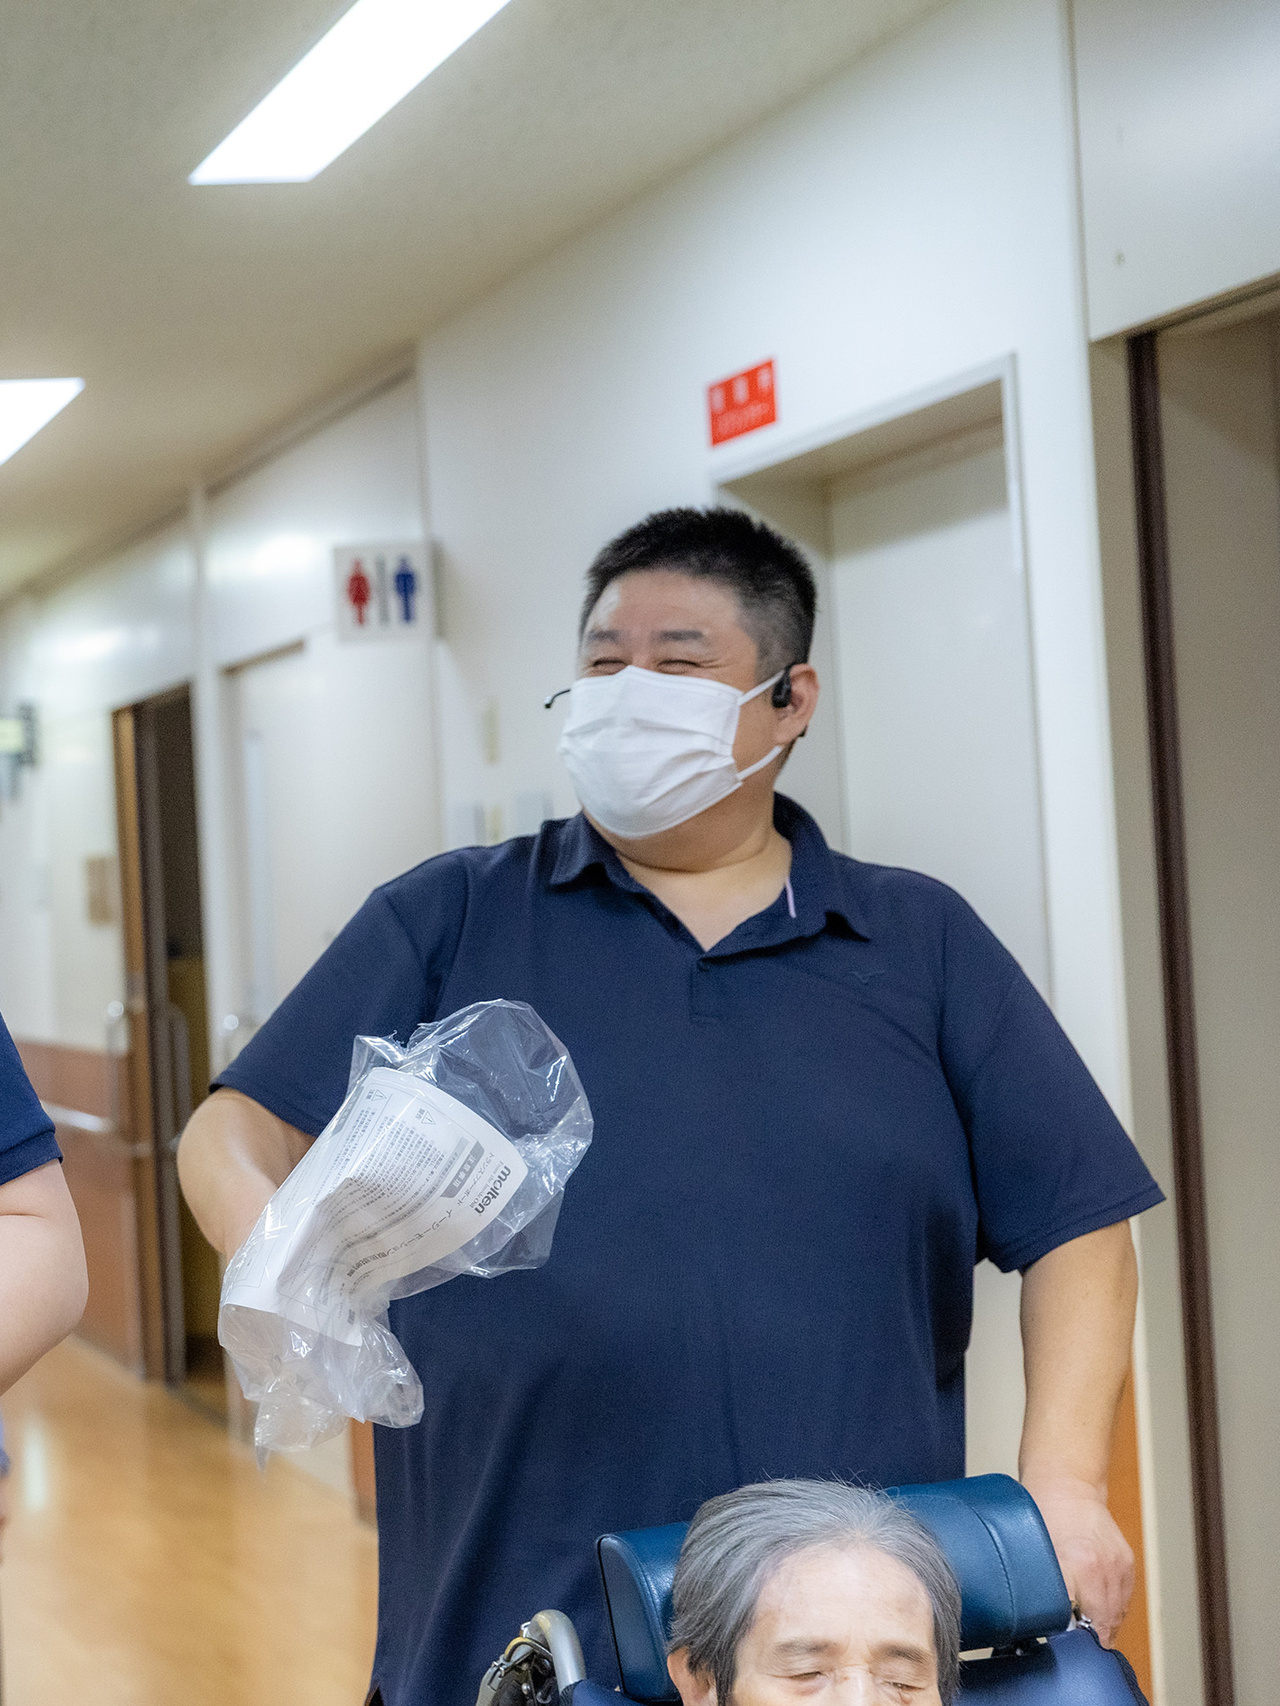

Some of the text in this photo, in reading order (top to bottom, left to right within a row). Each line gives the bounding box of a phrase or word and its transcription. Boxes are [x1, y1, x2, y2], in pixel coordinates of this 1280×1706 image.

[453, 1154, 476, 1188] 注意事項
[457, 1152, 495, 1206] トランスファーボード
[475, 1166, 511, 1214] molten
